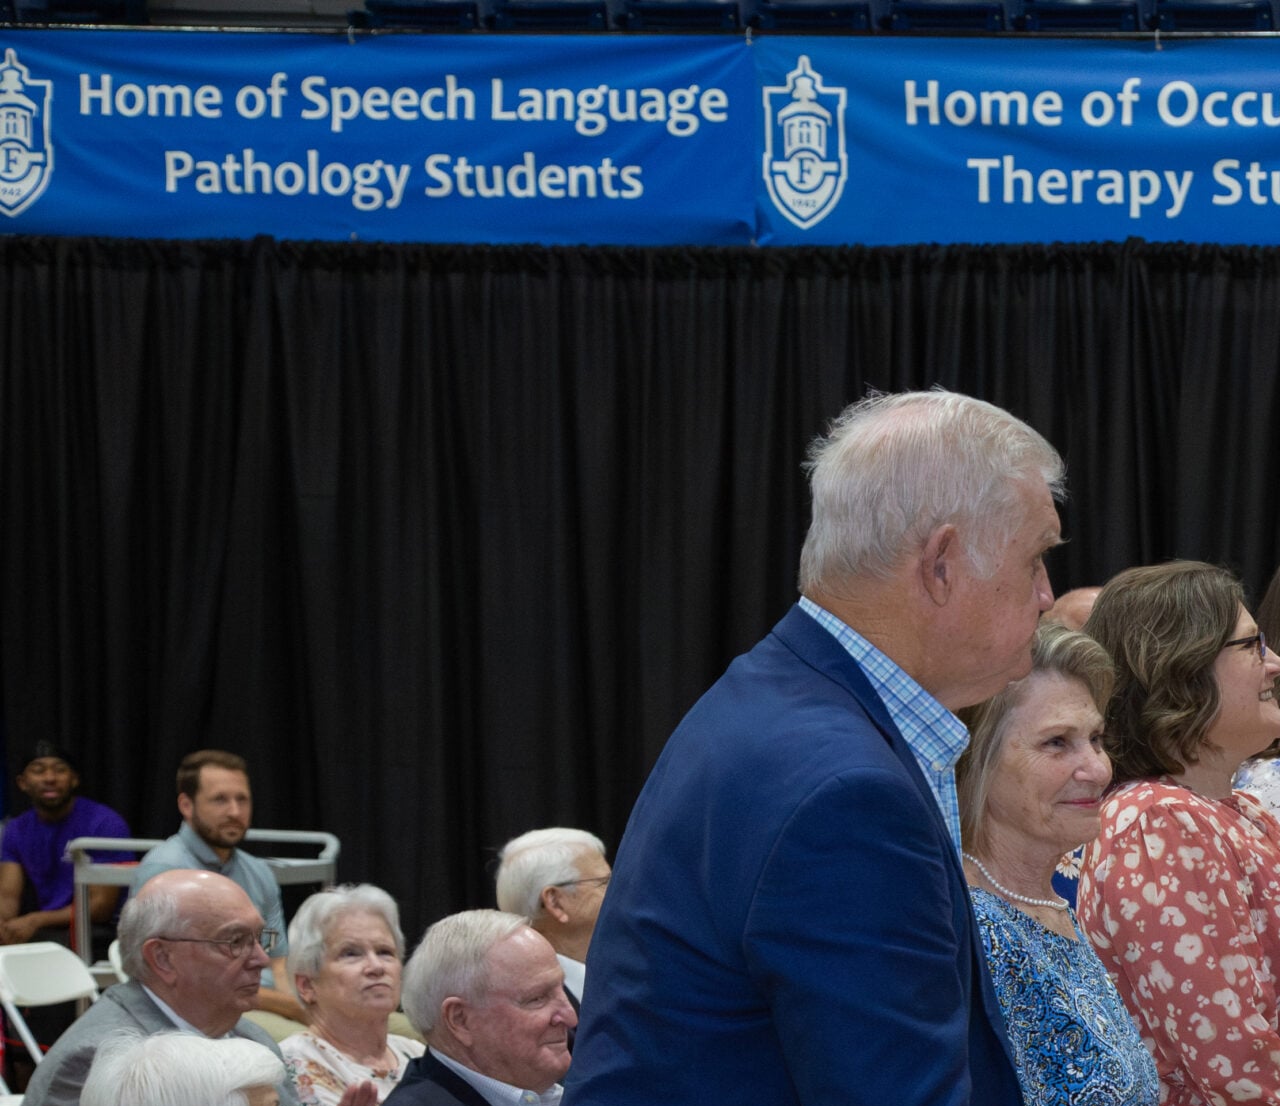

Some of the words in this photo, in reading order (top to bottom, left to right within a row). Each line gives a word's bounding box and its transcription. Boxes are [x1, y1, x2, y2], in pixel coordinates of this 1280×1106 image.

[79, 73, 222, 118] Home
[235, 72, 287, 119] of
[301, 75, 475, 132] Speech
[491, 78, 728, 136] Language
[904, 80, 1063, 126] Home
[1081, 77, 1142, 127] of
[3, 147, 21, 173] F
[165, 148, 410, 210] Pathology
[425, 152, 643, 199] Students
[796, 156, 815, 184] F
[0, 186, 21, 196] 942
[967, 155, 1193, 218] Therapy
